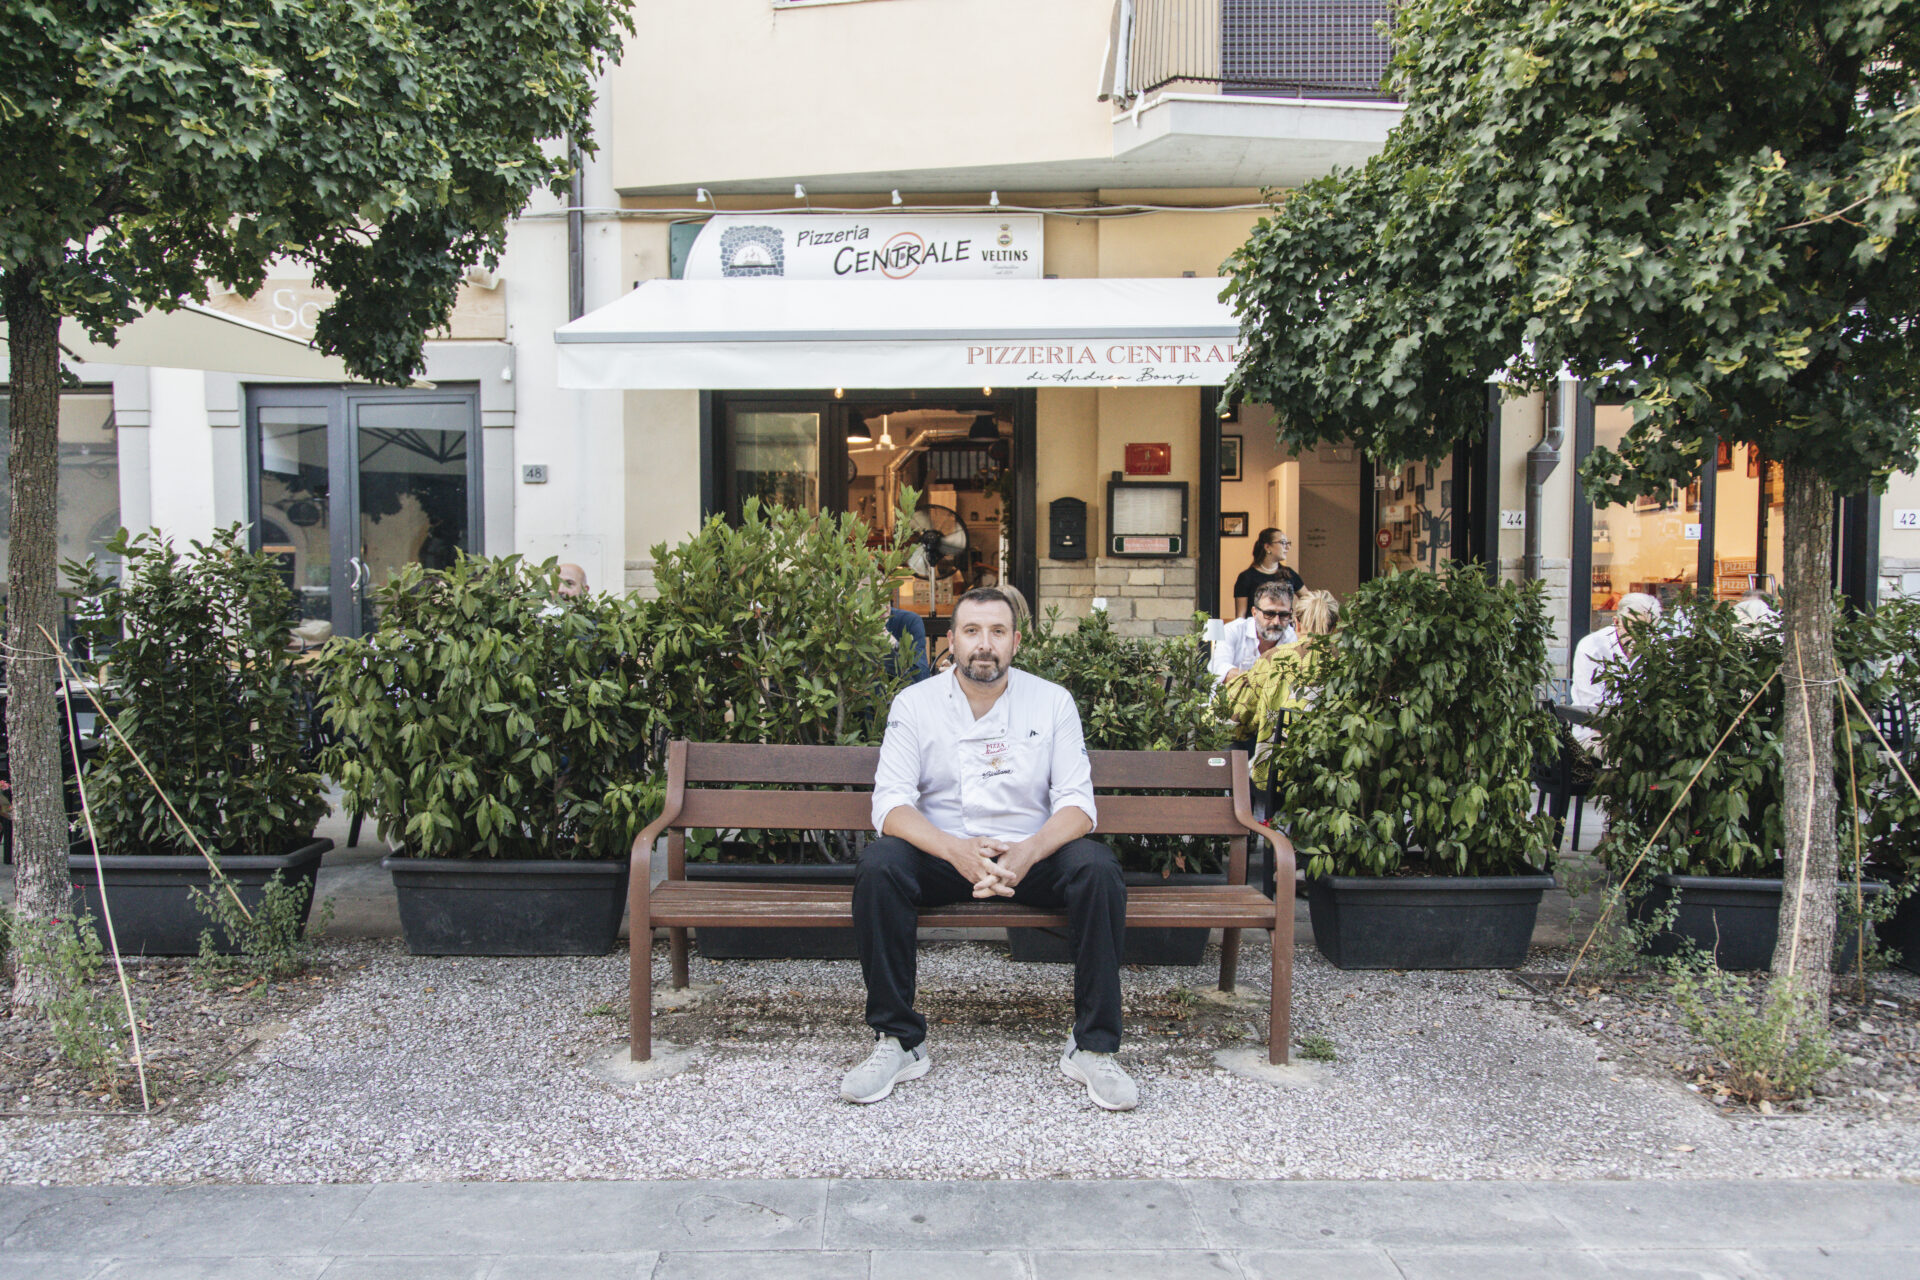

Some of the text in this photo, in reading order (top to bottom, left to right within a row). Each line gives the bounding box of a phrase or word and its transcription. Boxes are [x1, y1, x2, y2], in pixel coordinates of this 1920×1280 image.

[797, 225, 870, 247] Pizzeria
[833, 240, 972, 276] CENTRALE
[981, 249, 1028, 262] VELTINS
[272, 288, 336, 330] So
[967, 344, 1248, 365] PIZZERIA CENTRAL
[1027, 367, 1199, 384] di Andrea Bongi
[526, 467, 542, 479] 48
[1507, 513, 1522, 526] 44
[1900, 513, 1917, 525] 42
[1724, 561, 1756, 570] PIZZERI
